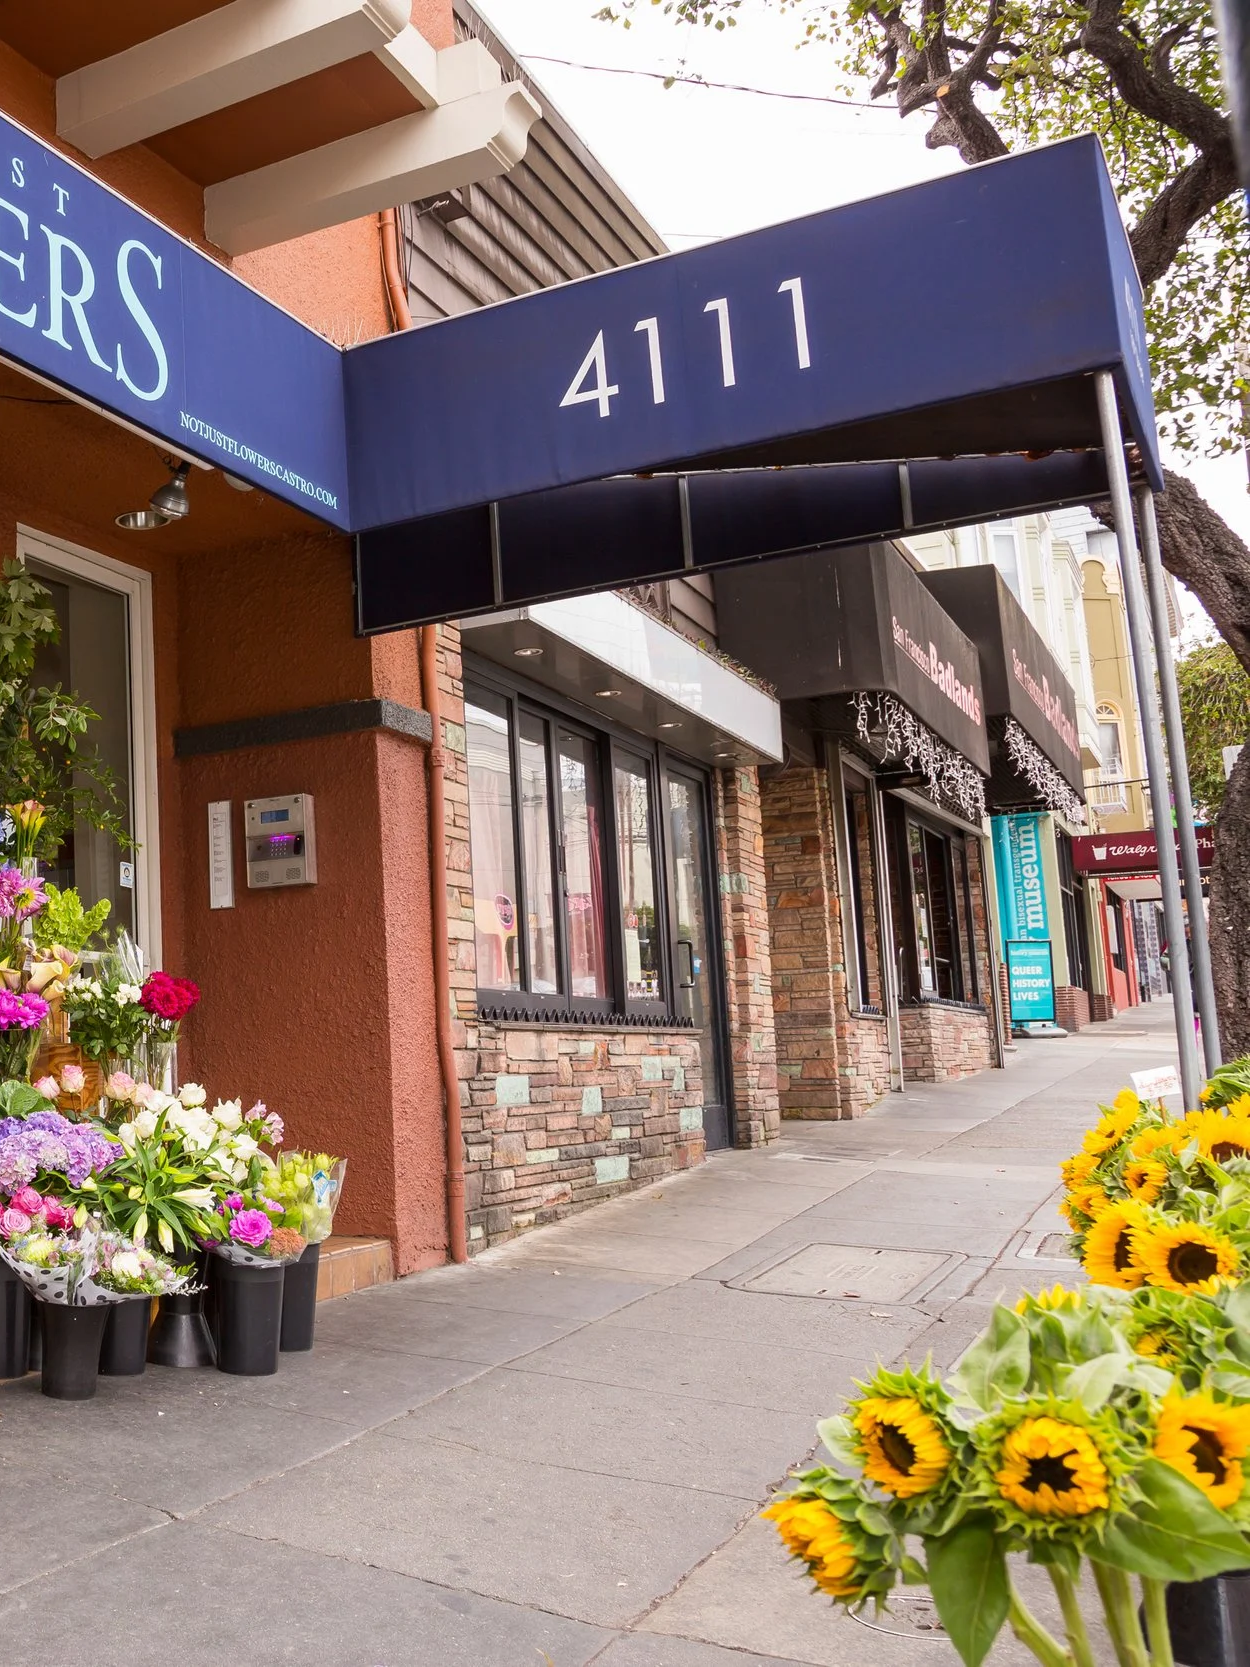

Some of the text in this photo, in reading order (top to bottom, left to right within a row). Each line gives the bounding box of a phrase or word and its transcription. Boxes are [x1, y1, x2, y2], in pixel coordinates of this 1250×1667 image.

[558, 276, 812, 418] 4111
[179, 410, 338, 510] NOTJUSTFLOWERSCASTRO.COM
[892, 615, 981, 727] San Francisco Badlands
[1108, 843, 1181, 858] Walgr
[1018, 820, 1045, 931] museum
[1015, 885, 1027, 927] bisexual
[1011, 965, 1043, 976] QUEER
[1012, 978, 1051, 988] HISTORY
[1013, 991, 1040, 1001] LIVES
